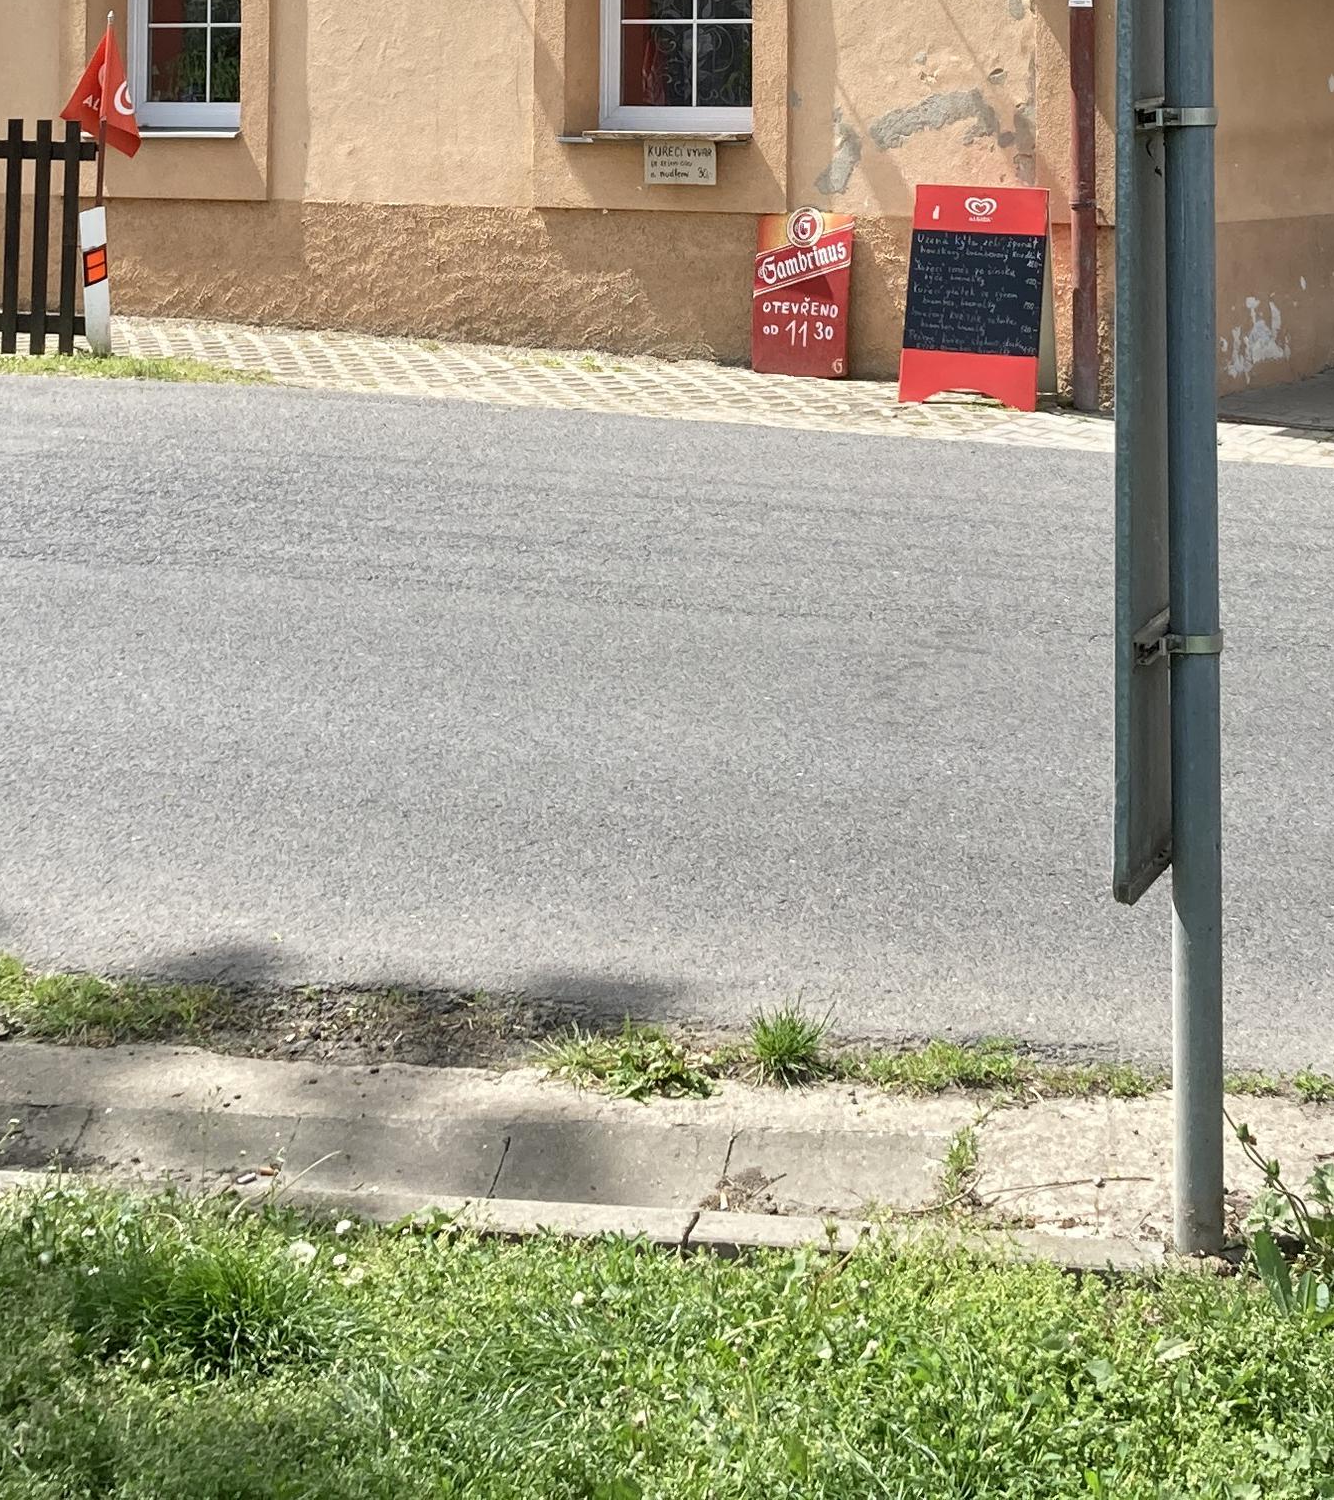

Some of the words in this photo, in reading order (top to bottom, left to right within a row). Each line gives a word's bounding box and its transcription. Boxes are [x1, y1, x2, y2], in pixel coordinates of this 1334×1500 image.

[758, 241, 847, 285] Gambrinus
[762, 297, 839, 318] OTEVŘENO
[762, 325, 779, 335] OD
[785, 320, 808, 347] 11
